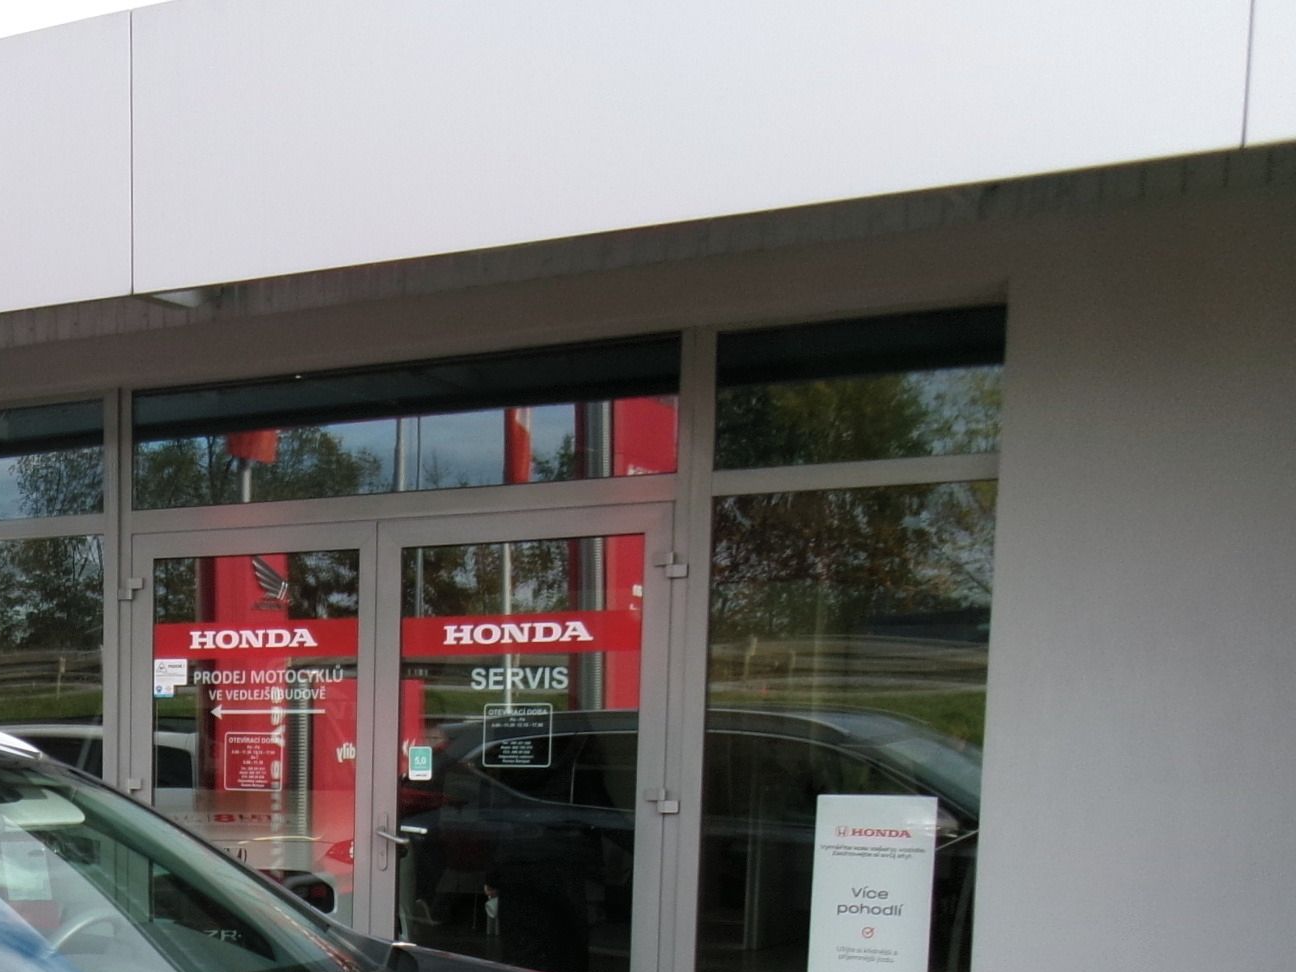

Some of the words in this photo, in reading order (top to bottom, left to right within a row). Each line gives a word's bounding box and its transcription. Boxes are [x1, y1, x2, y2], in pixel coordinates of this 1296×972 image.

[189, 628, 318, 650] HONDA
[443, 621, 594, 645] HONDA
[193, 670, 245, 684] PRODEJ
[251, 665, 344, 684] MOTOCYKLŮ
[470, 667, 569, 690] SERVIS
[209, 689, 222, 700] VE
[277, 686, 326, 700] BUDOVĚ
[851, 828, 912, 838] HONDA
[851, 886, 889, 899] Více
[837, 903, 904, 916] pohodlí
